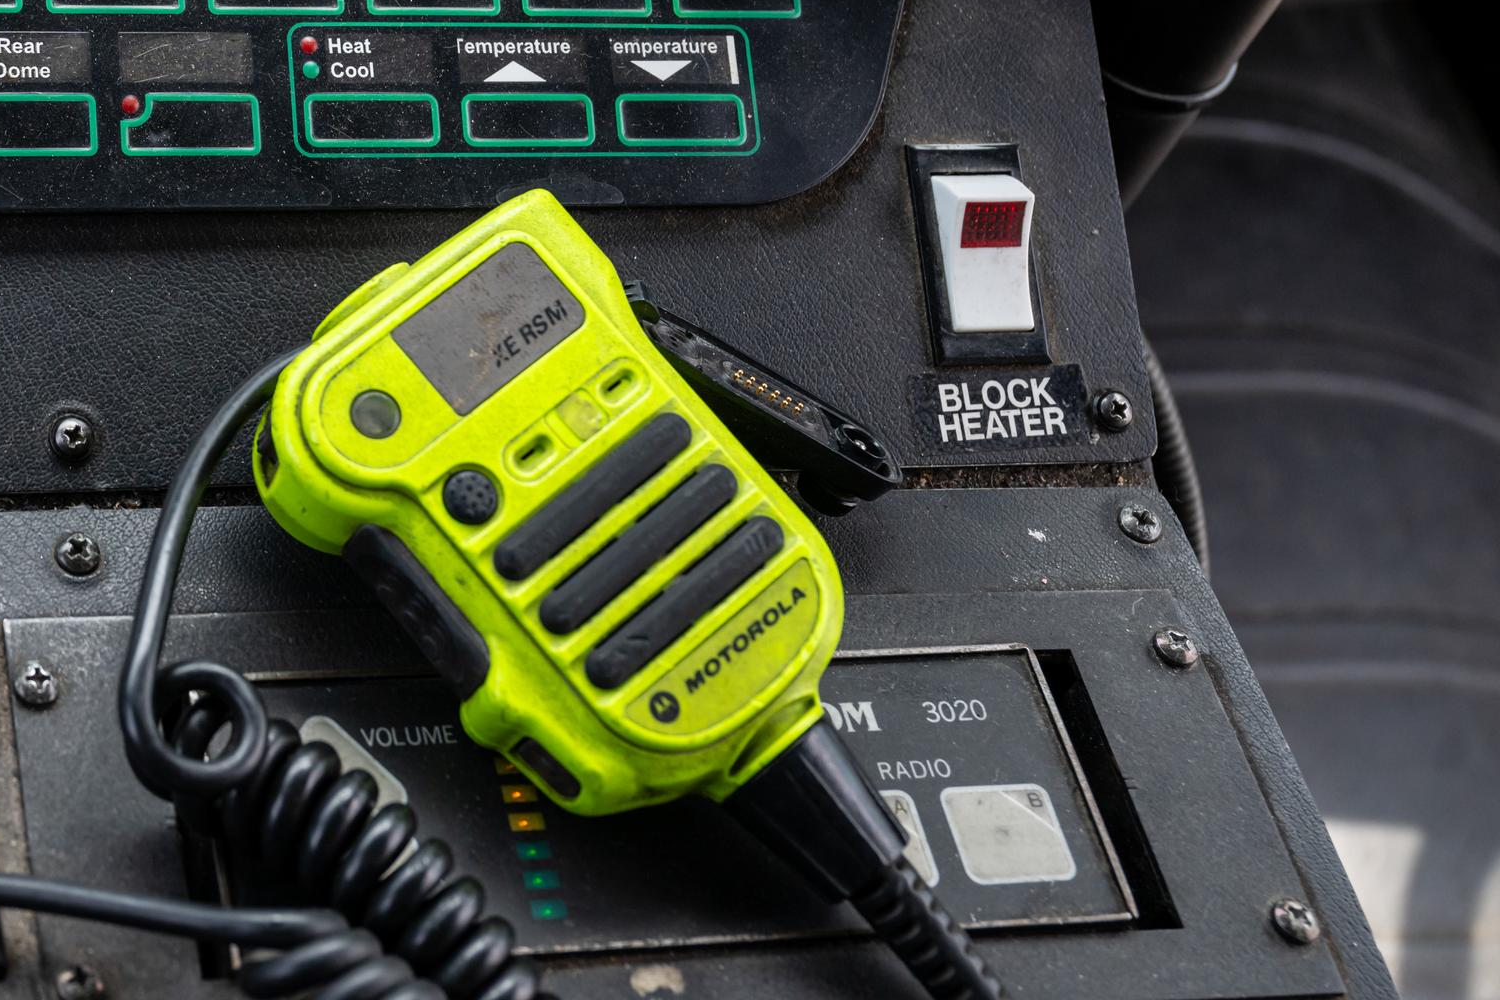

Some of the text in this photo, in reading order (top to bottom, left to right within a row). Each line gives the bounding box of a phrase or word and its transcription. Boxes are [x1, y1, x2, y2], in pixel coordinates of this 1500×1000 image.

[328, 37, 371, 54] Heat
[457, 38, 571, 58] Temperature
[609, 38, 719, 58] emperature
[330, 62, 375, 79] Cool
[519, 299, 567, 345] RSM
[938, 376, 1057, 413] BLOCK
[938, 407, 1067, 443] HEATER
[685, 585, 806, 696] MOTOROLA
[922, 699, 988, 724] 3020
[360, 724, 457, 749] VOLUME
[877, 758, 951, 781] RADIO
[894, 799, 909, 815] A
[1027, 792, 1043, 808] B
